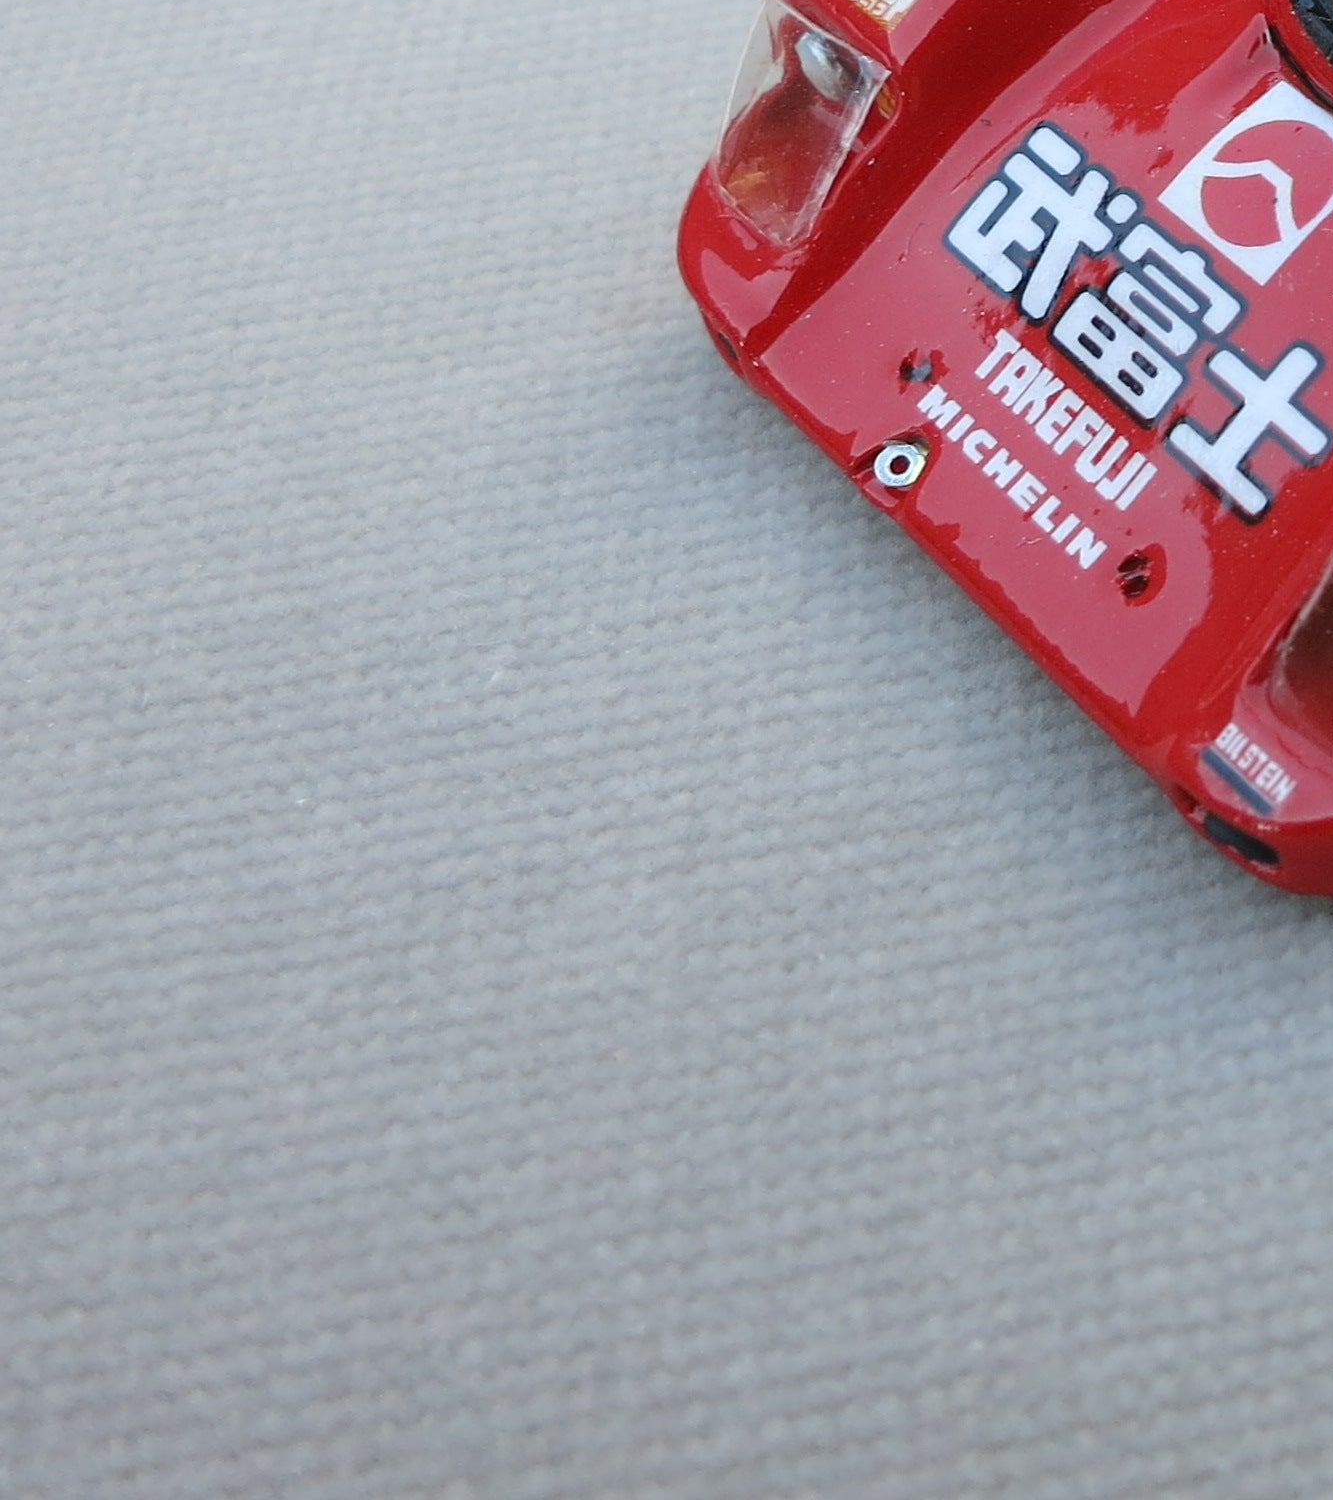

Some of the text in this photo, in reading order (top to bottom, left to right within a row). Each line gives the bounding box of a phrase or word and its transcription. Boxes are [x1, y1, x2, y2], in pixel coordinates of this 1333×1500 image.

[944, 122, 1333, 522] 武富士
[916, 389, 1110, 571] MICHELIN
[972, 328, 1158, 511] TAKEFUJI
[1214, 722, 1298, 803] BILSTEIN
